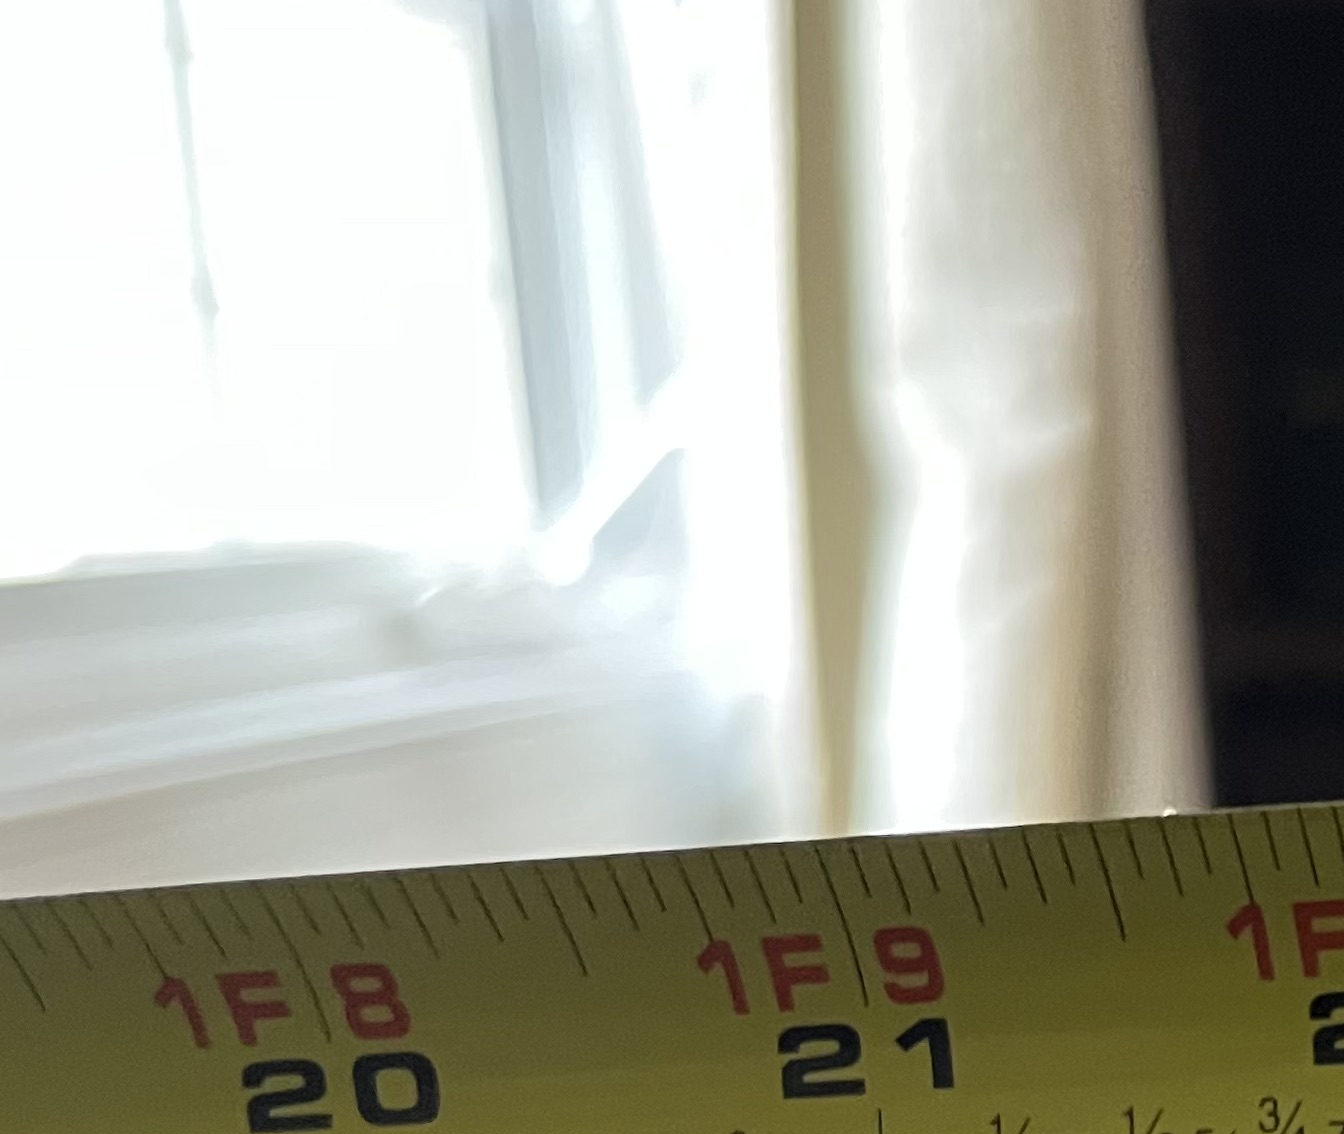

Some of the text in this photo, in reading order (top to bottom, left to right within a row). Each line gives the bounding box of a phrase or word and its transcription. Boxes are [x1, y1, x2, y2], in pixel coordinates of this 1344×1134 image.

[154, 962, 412, 1050] 1F 8
[696, 926, 946, 1016] 1F 9
[241, 1050, 441, 1134] 20
[777, 1017, 956, 1100] 21
